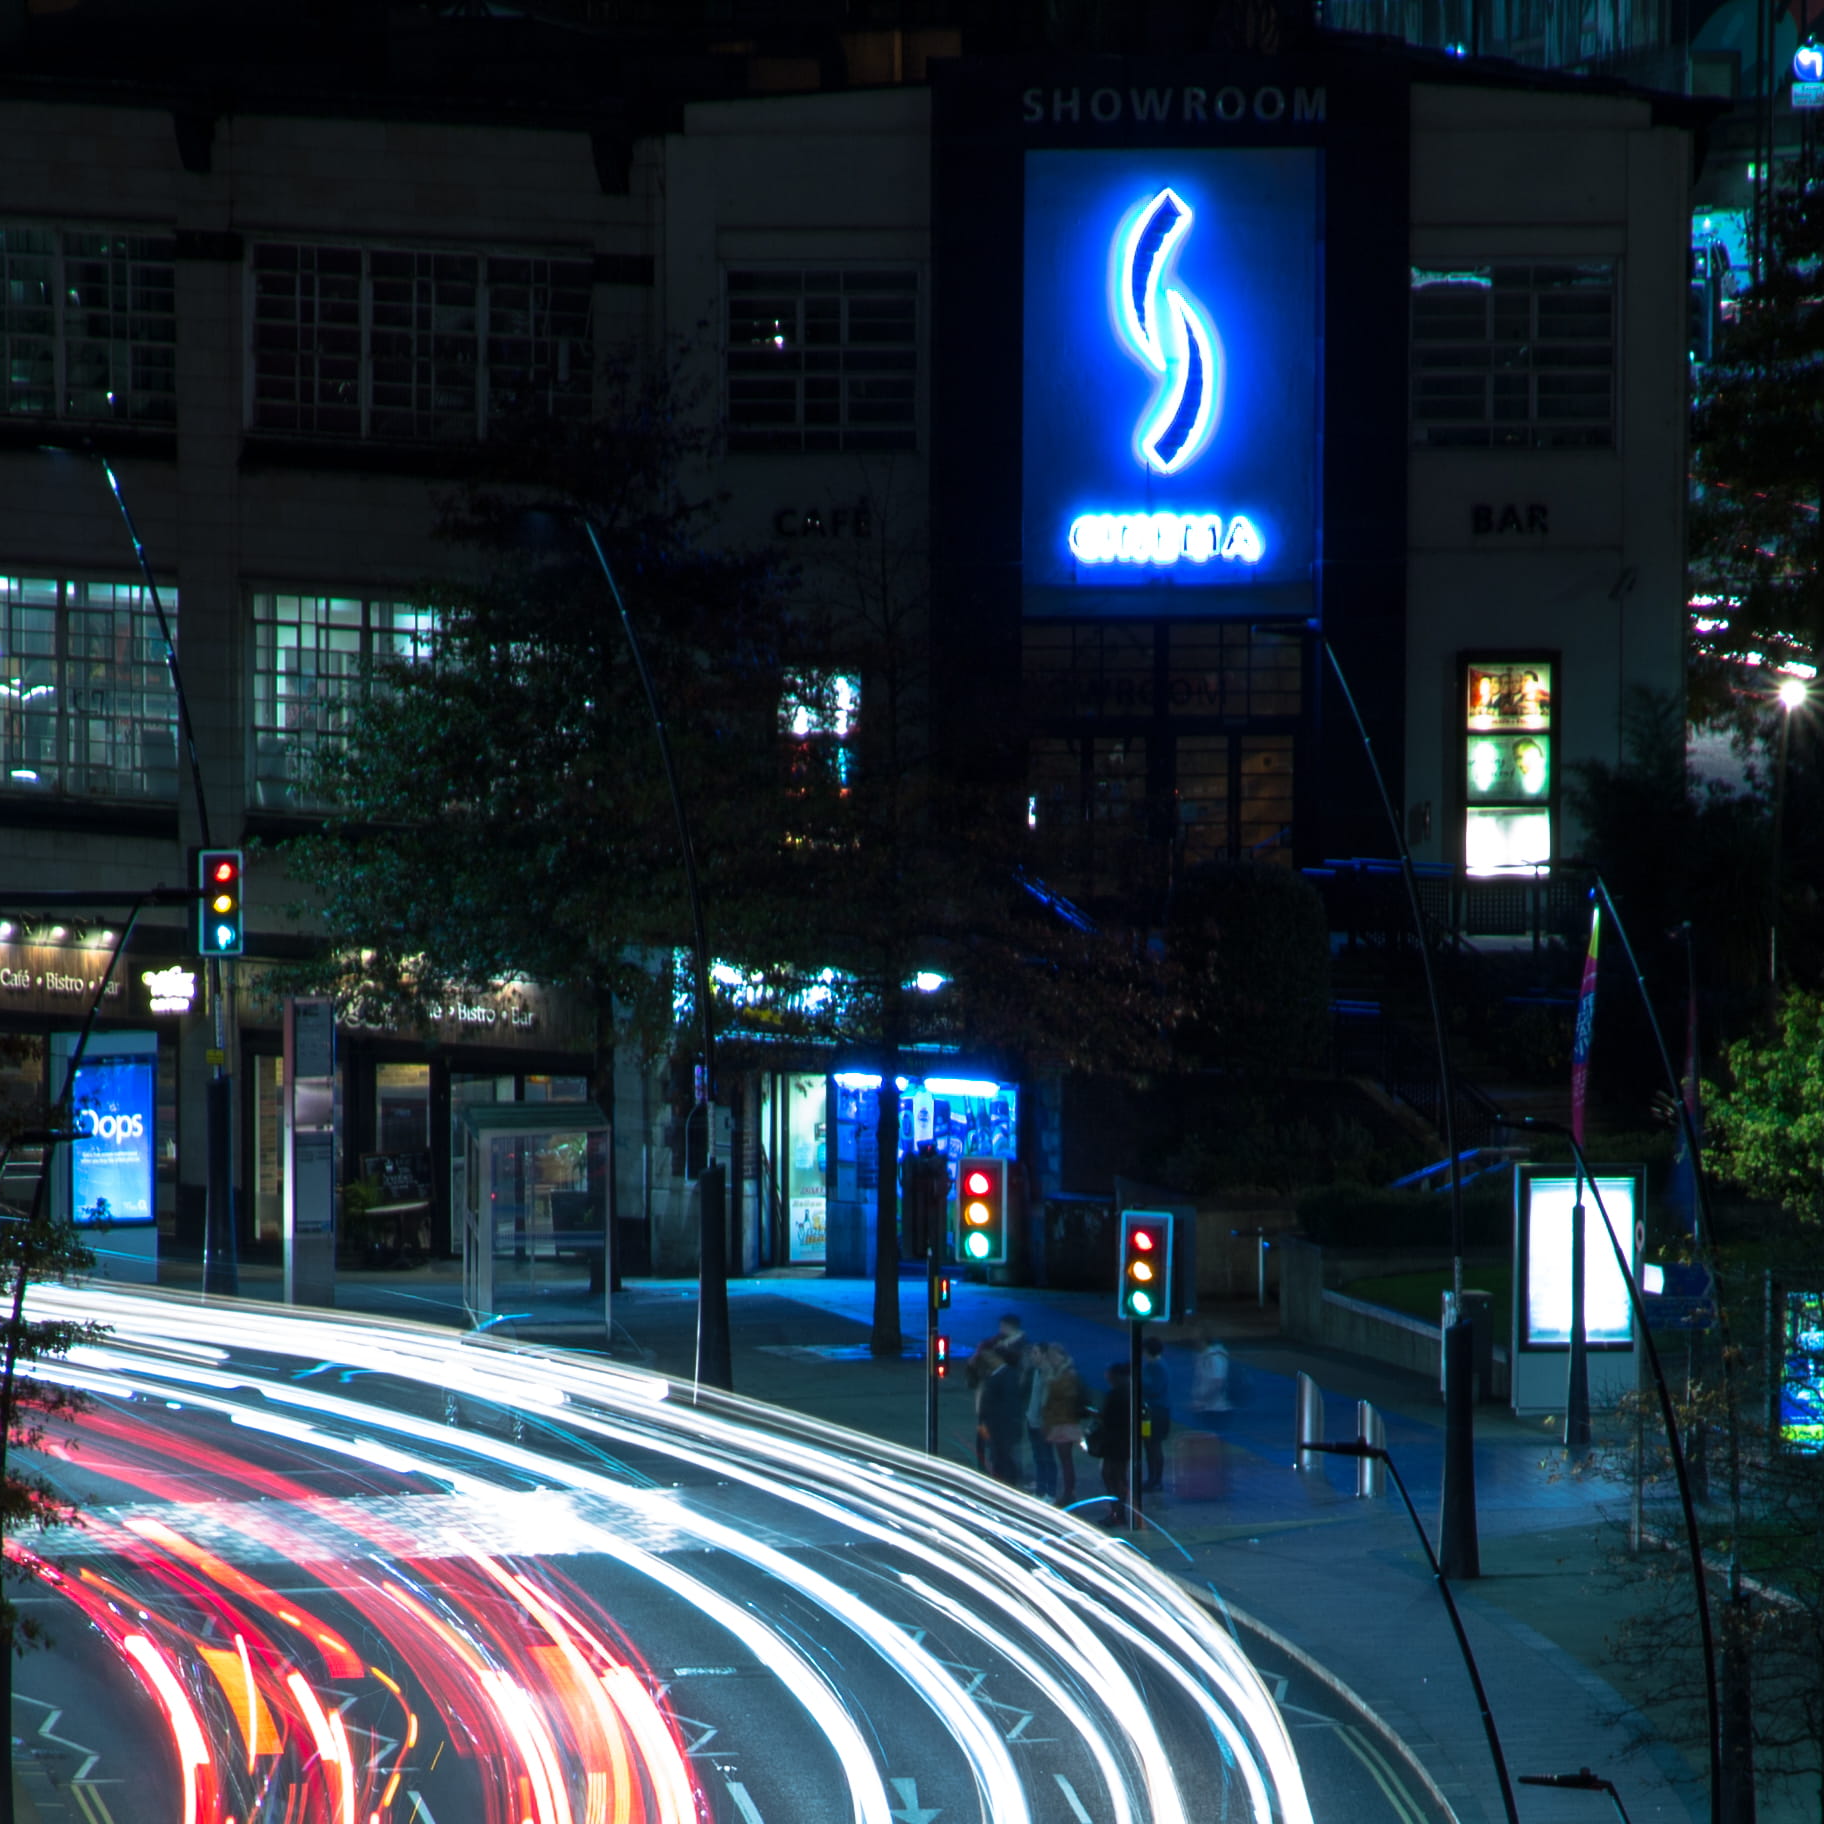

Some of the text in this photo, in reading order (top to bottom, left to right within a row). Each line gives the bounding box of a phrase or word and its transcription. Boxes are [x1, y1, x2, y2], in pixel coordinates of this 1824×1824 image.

[1023, 86, 1327, 121] SHOWROOM
[1472, 503, 1549, 534] BAR
[0, 968, 30, 987] Café
[46, 973, 84, 993] Bistro
[458, 1002, 496, 1023] Bistro
[511, 1004, 534, 1026] Bar
